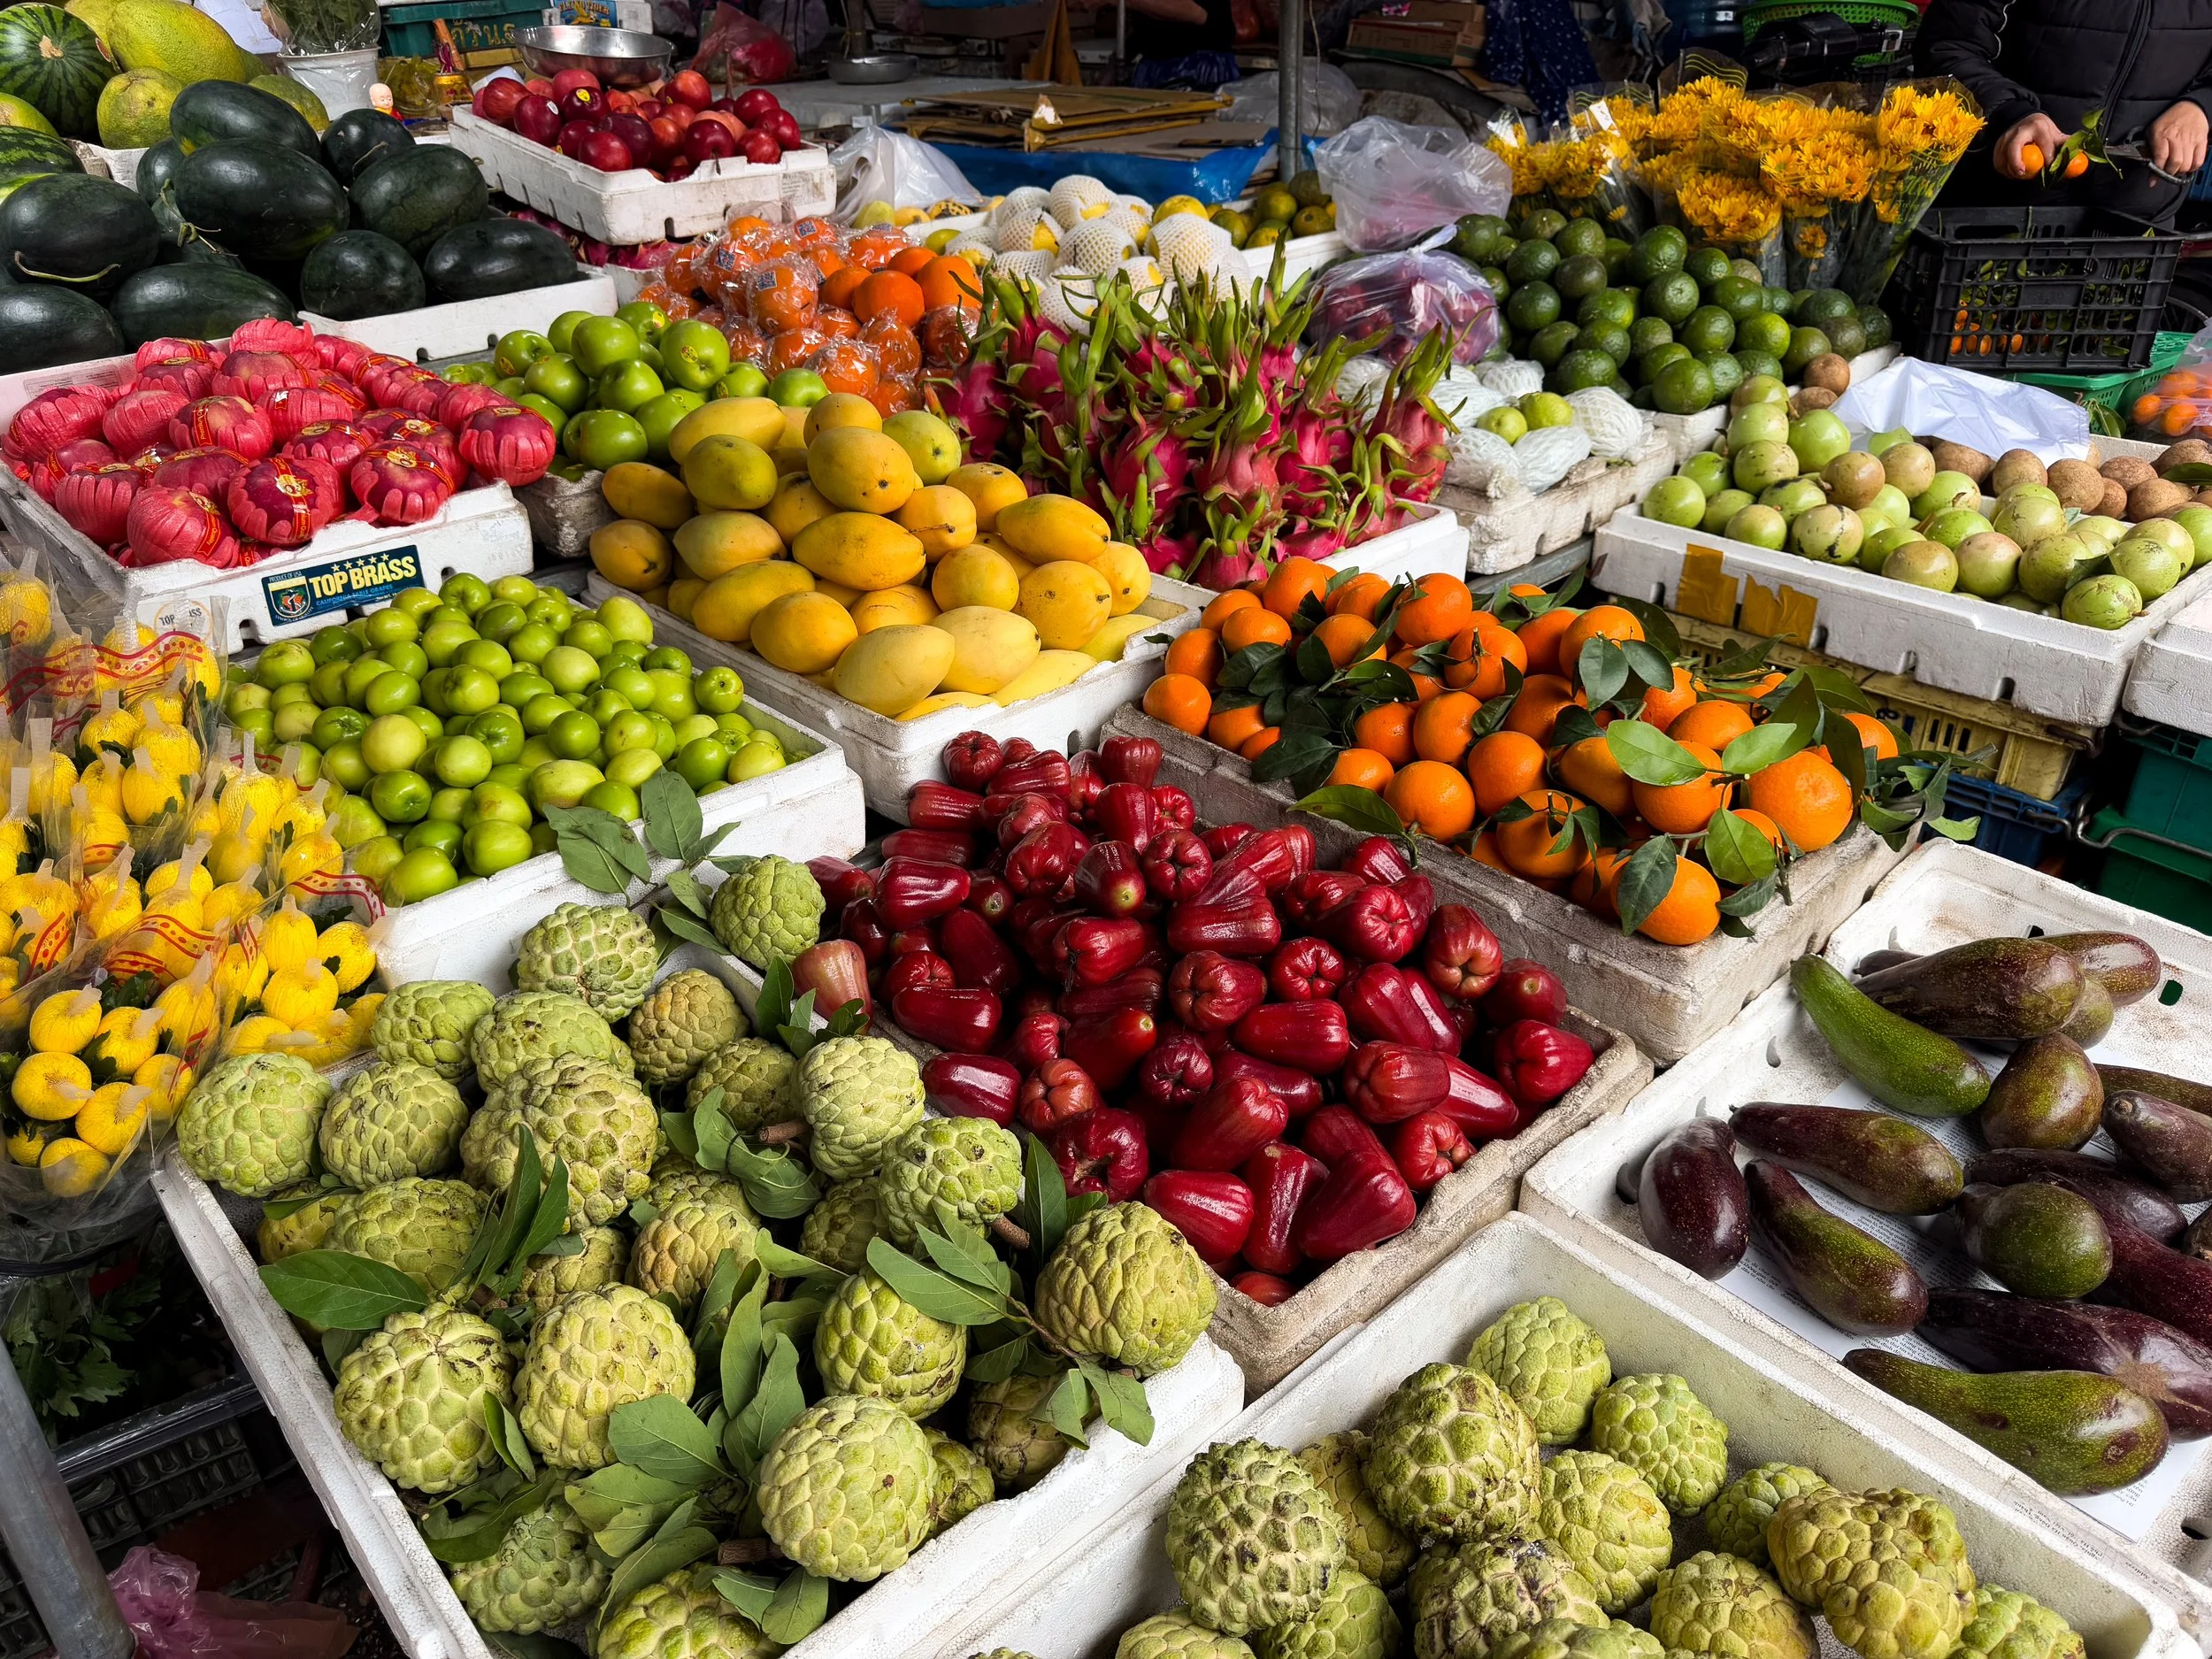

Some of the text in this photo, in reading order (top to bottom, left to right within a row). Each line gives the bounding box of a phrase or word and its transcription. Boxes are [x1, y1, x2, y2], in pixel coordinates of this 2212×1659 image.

[309, 556, 418, 599] TOP BRASS
[370, 585, 393, 595] GRAPES
[158, 614, 175, 626] TOP
